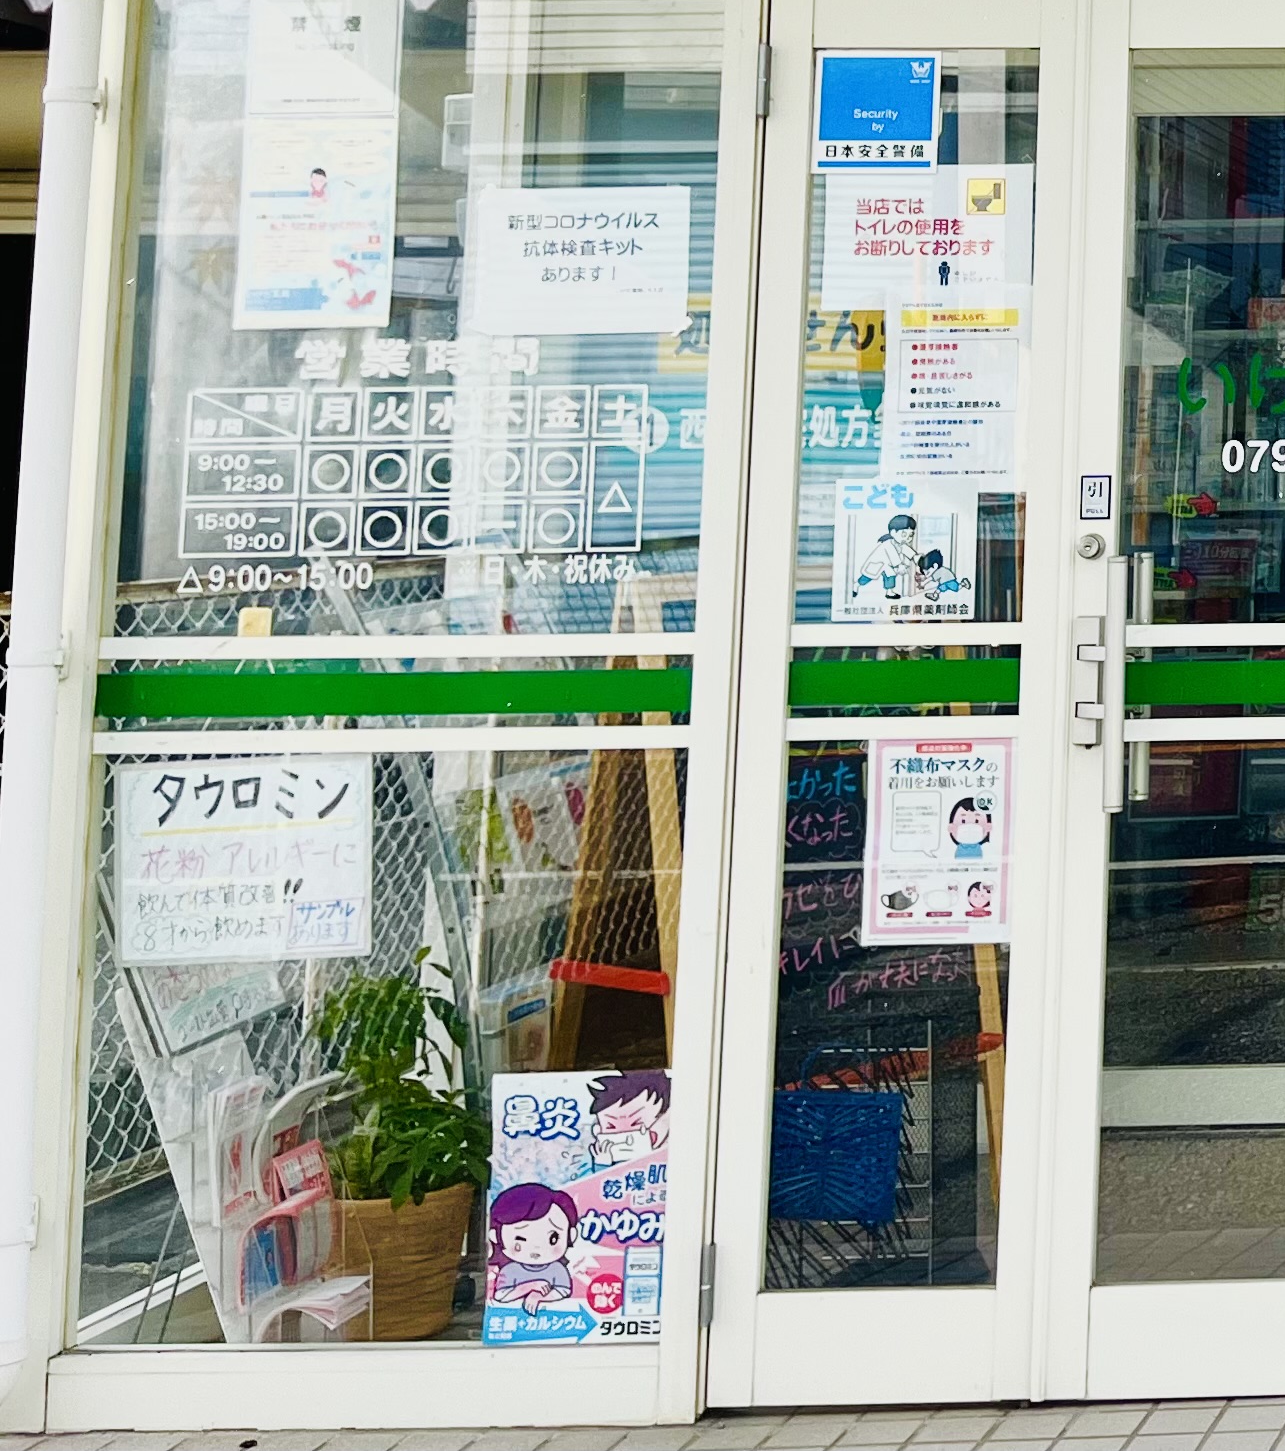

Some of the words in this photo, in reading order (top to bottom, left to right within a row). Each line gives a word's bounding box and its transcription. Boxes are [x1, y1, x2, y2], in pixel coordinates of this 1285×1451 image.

[853, 108, 899, 121] Security
[871, 121, 885, 134] by
[825, 143, 925, 159] 日本安全警備
[855, 197, 925, 215] 当店では
[506, 212, 660, 231] 新型コロナウイルス
[854, 218, 967, 236] トイレの使用を
[522, 237, 644, 258] 抗体検査キット
[853, 239, 995, 257] お断りしております
[315, 396, 351, 432] 月
[371, 395, 411, 431] 火
[543, 394, 582, 428] 金
[601, 394, 638, 427] 土
[221, 473, 284, 493] 12:30
[1087, 481, 1103, 498] 引
[842, 483, 914, 510] こども
[223, 532, 286, 551] 19:00
[889, 756, 998, 775] 不織布マスクの
[151, 768, 350, 828] タウロミン
[296, 900, 356, 925] サンプル
[502, 1095, 580, 1141] 鼻炎
[602, 1164, 667, 1200] 乾燥肌
[579, 1206, 666, 1244] かゆみ
